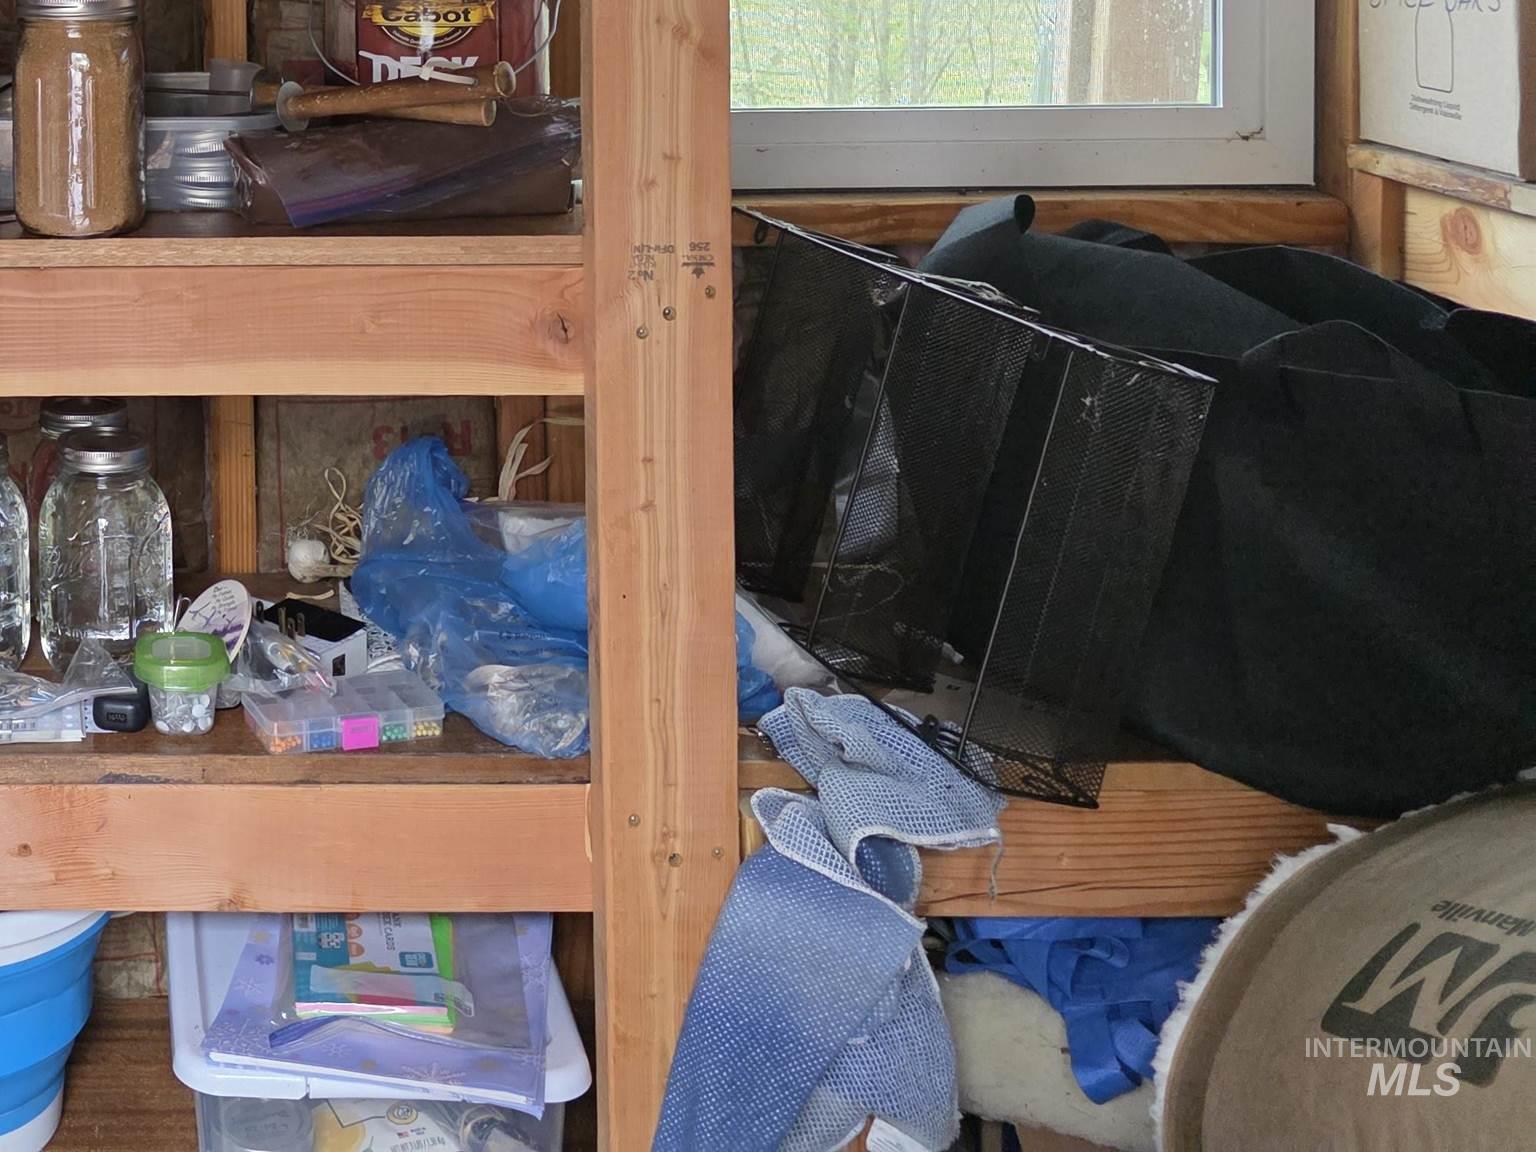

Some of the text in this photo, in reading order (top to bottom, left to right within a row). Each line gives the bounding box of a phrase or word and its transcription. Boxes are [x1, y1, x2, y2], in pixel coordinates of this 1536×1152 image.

[381, 3, 472, 23] Cabot
[688, 241, 712, 252] 256
[1430, 899, 1536, 938] Manville
[384, 927, 396, 951] CARDS
